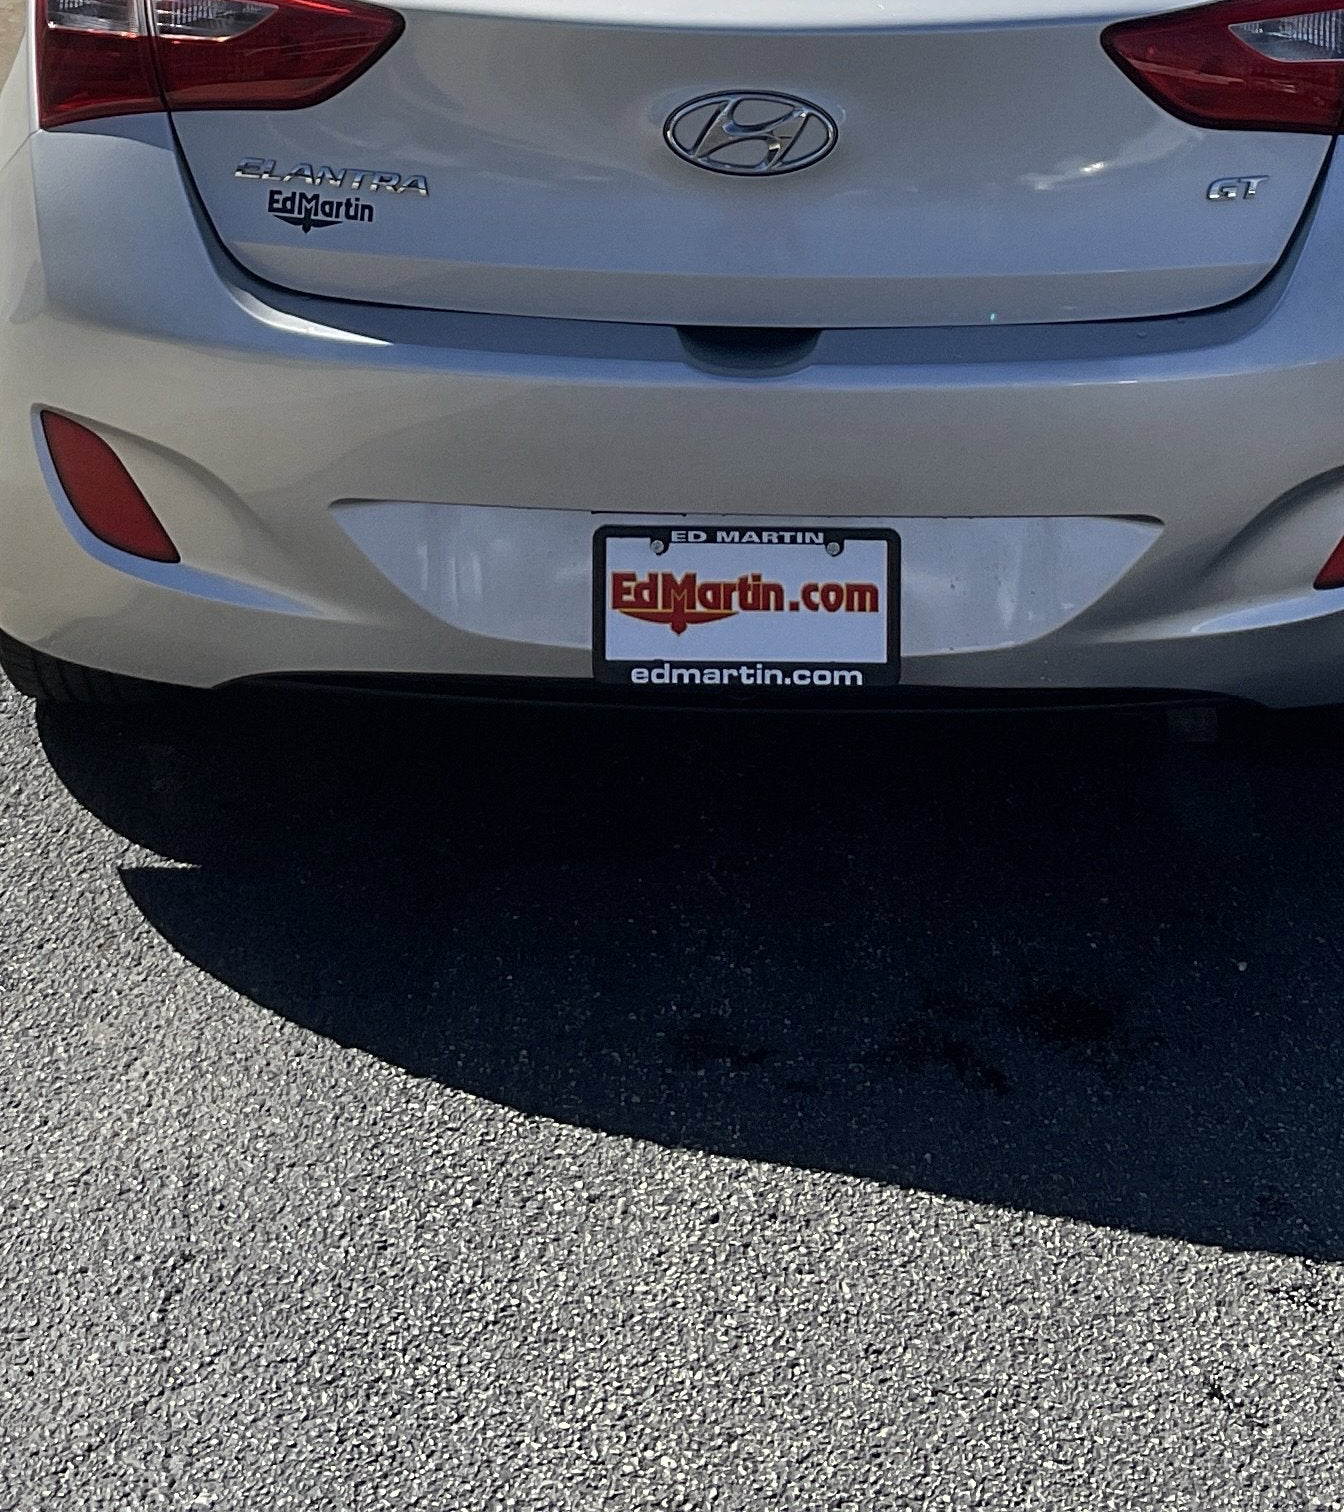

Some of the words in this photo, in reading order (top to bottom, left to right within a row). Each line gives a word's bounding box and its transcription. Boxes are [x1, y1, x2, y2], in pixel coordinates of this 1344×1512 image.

[235, 157, 429, 197] ELANTRA
[1207, 175, 1270, 201] GT
[268, 189, 374, 222] EdMartin
[671, 531, 706, 543] ED
[716, 531, 824, 544] MARTIN
[612, 571, 879, 613] EdMartin.com
[631, 664, 863, 686] edmartin.com
